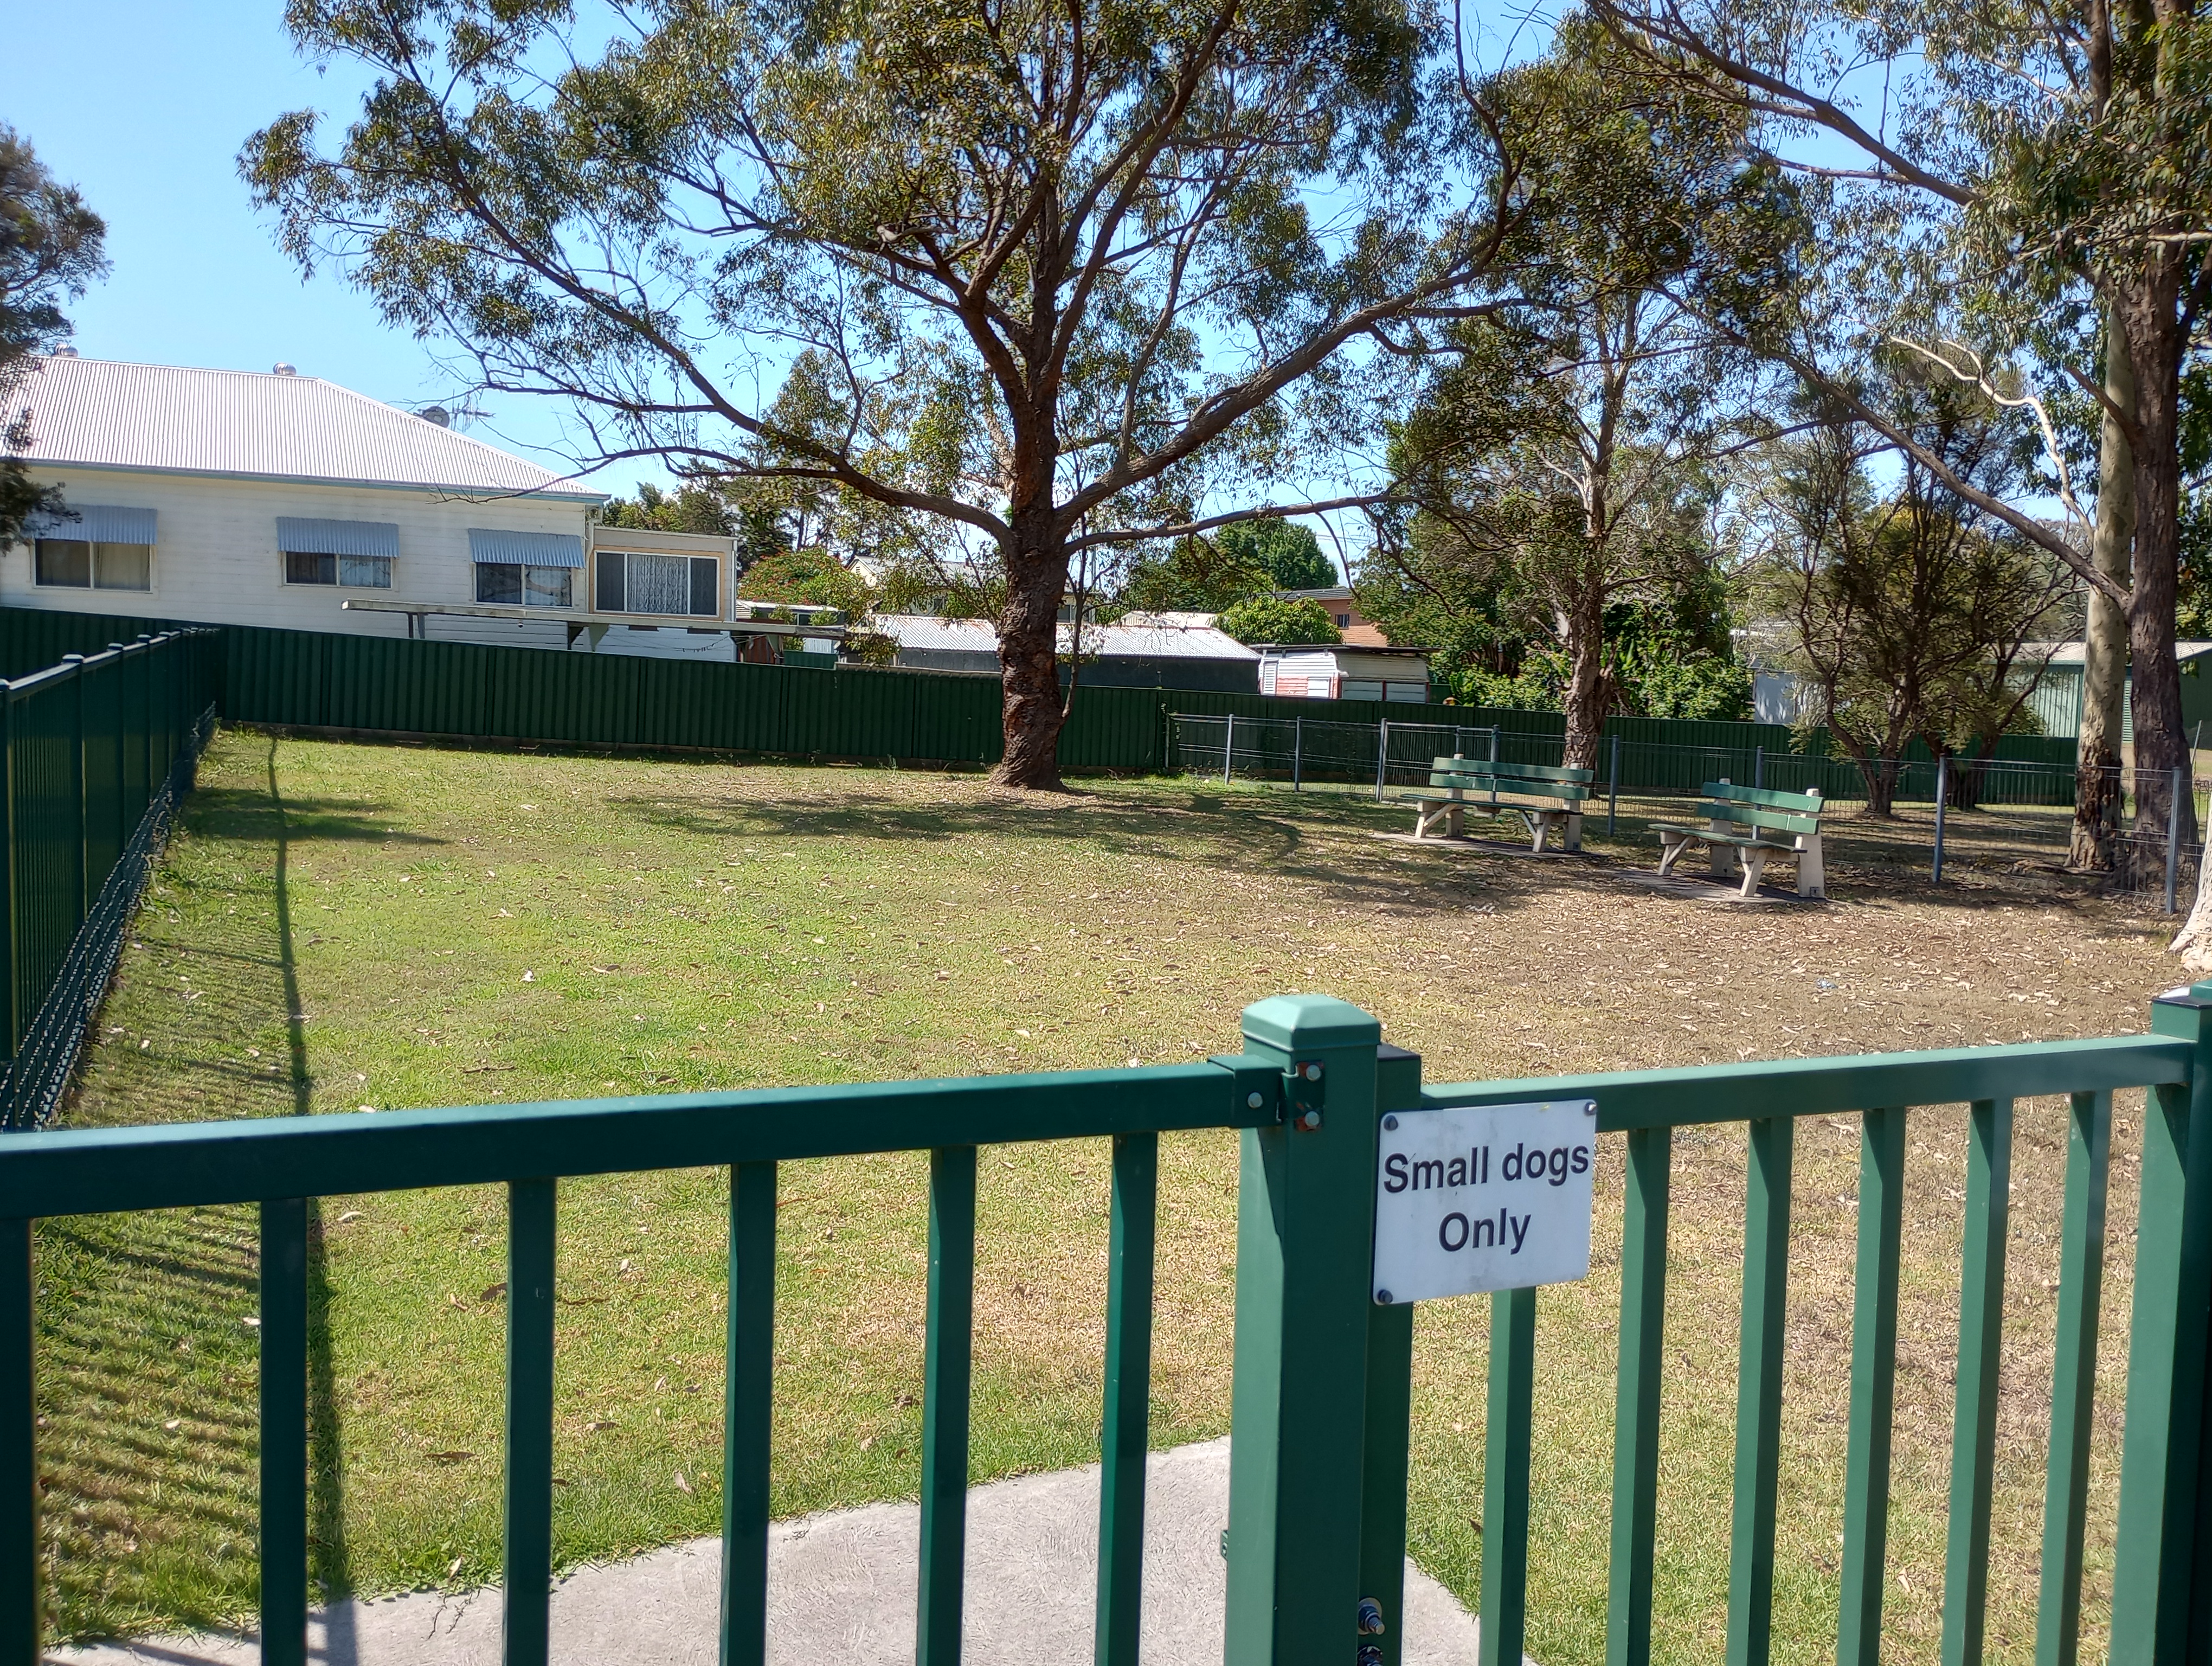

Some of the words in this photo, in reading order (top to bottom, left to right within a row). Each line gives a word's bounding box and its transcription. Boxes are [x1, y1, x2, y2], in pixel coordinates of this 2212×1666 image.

[1383, 1145, 1489, 1193] Small
[1501, 1142, 1589, 1187] dogs
[1438, 1207, 1532, 1255] Only
